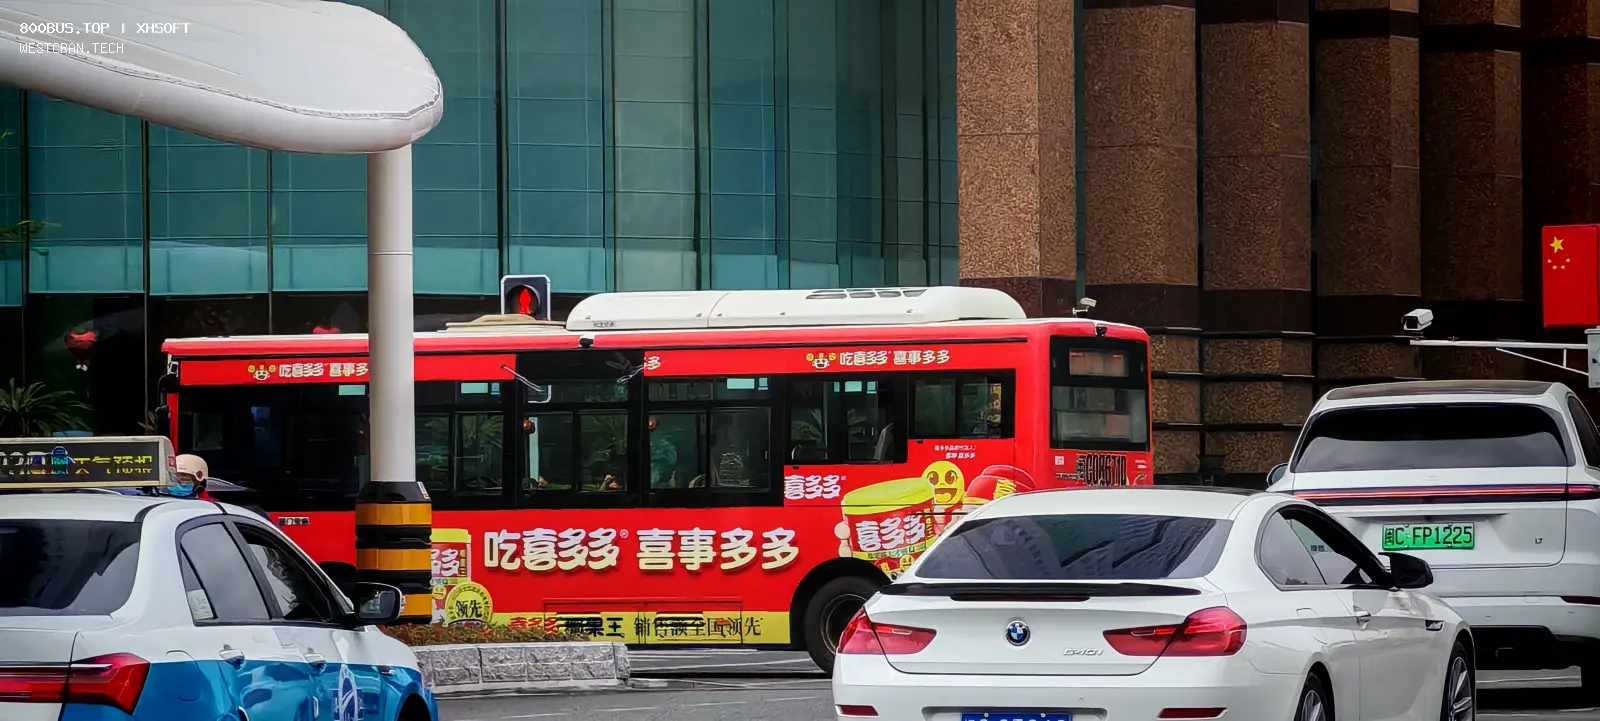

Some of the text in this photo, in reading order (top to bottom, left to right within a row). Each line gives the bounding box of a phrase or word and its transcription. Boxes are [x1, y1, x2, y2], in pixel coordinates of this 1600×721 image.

[893, 349, 950, 365] 喜事多多
[783, 474, 841, 500] 喜多多
[855, 513, 926, 552] 喜多多
[1412, 526, 1472, 545] FP1225
[636, 526, 800, 572] 喜事多多
